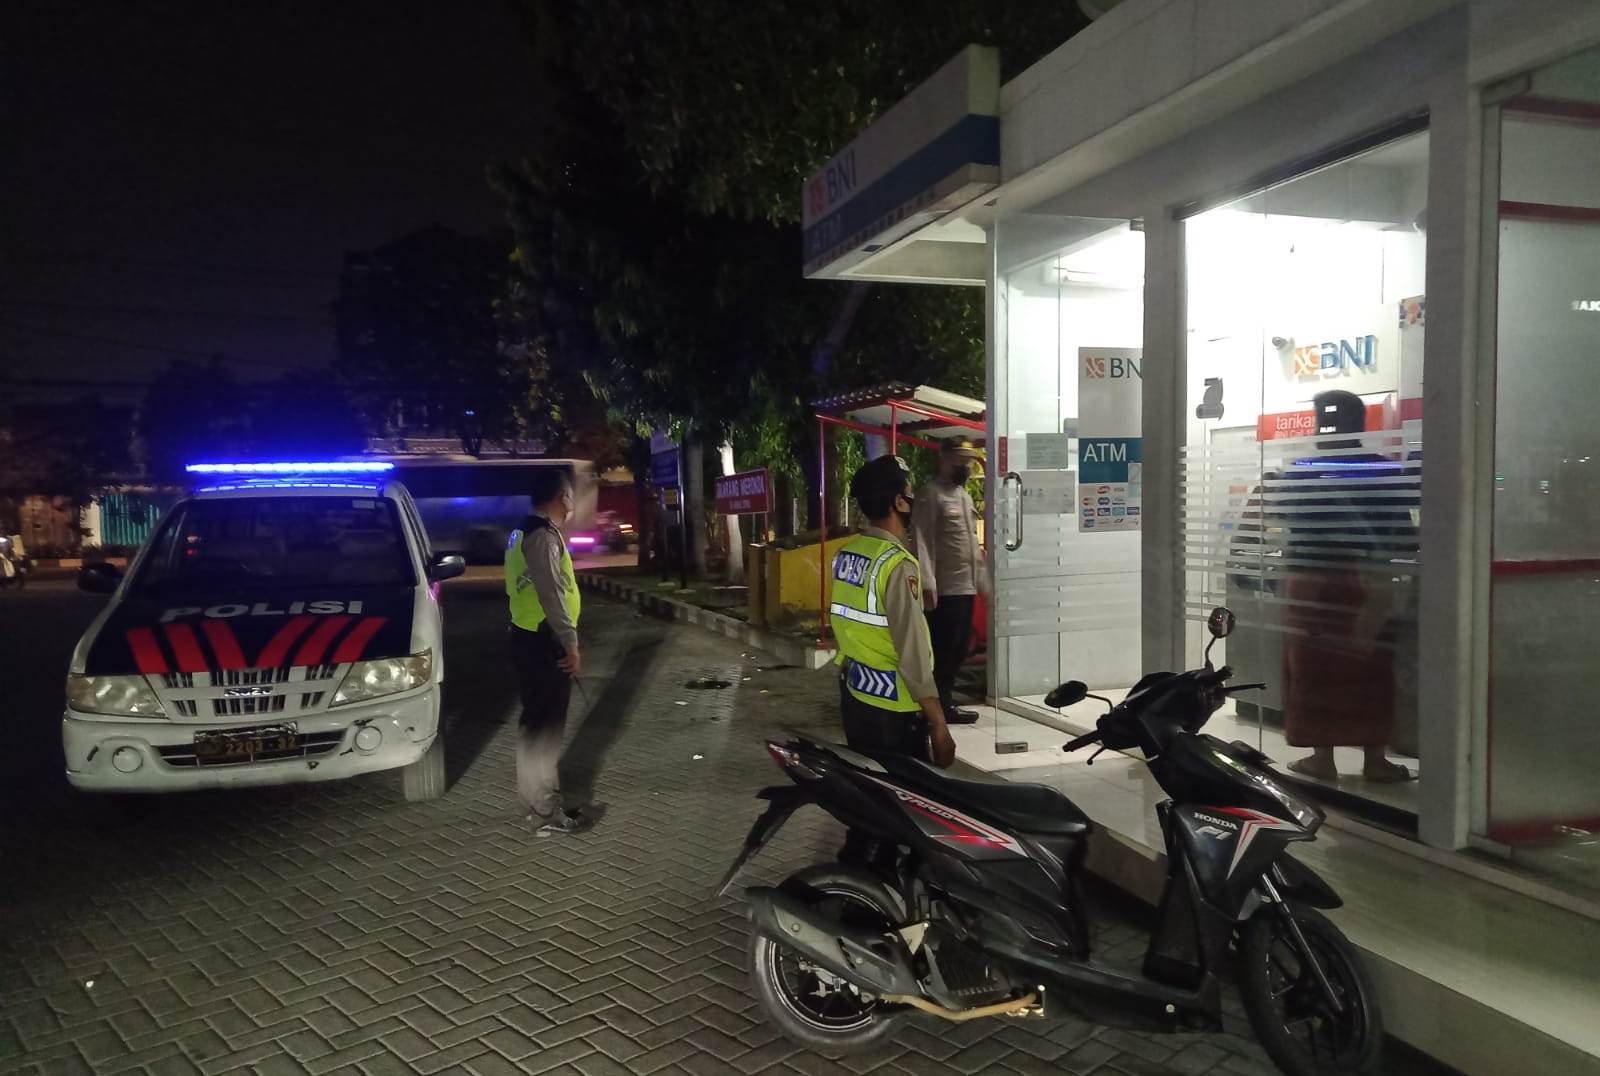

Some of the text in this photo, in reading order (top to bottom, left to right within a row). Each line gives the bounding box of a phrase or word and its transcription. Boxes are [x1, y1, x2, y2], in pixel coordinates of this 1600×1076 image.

[826, 149, 857, 204] BNI
[1321, 334, 1376, 370] BNI
[1110, 357, 1143, 379] BN
[1083, 443, 1127, 462] ATM
[159, 600, 362, 623] POLISI
[1193, 811, 1239, 830] HONDA
